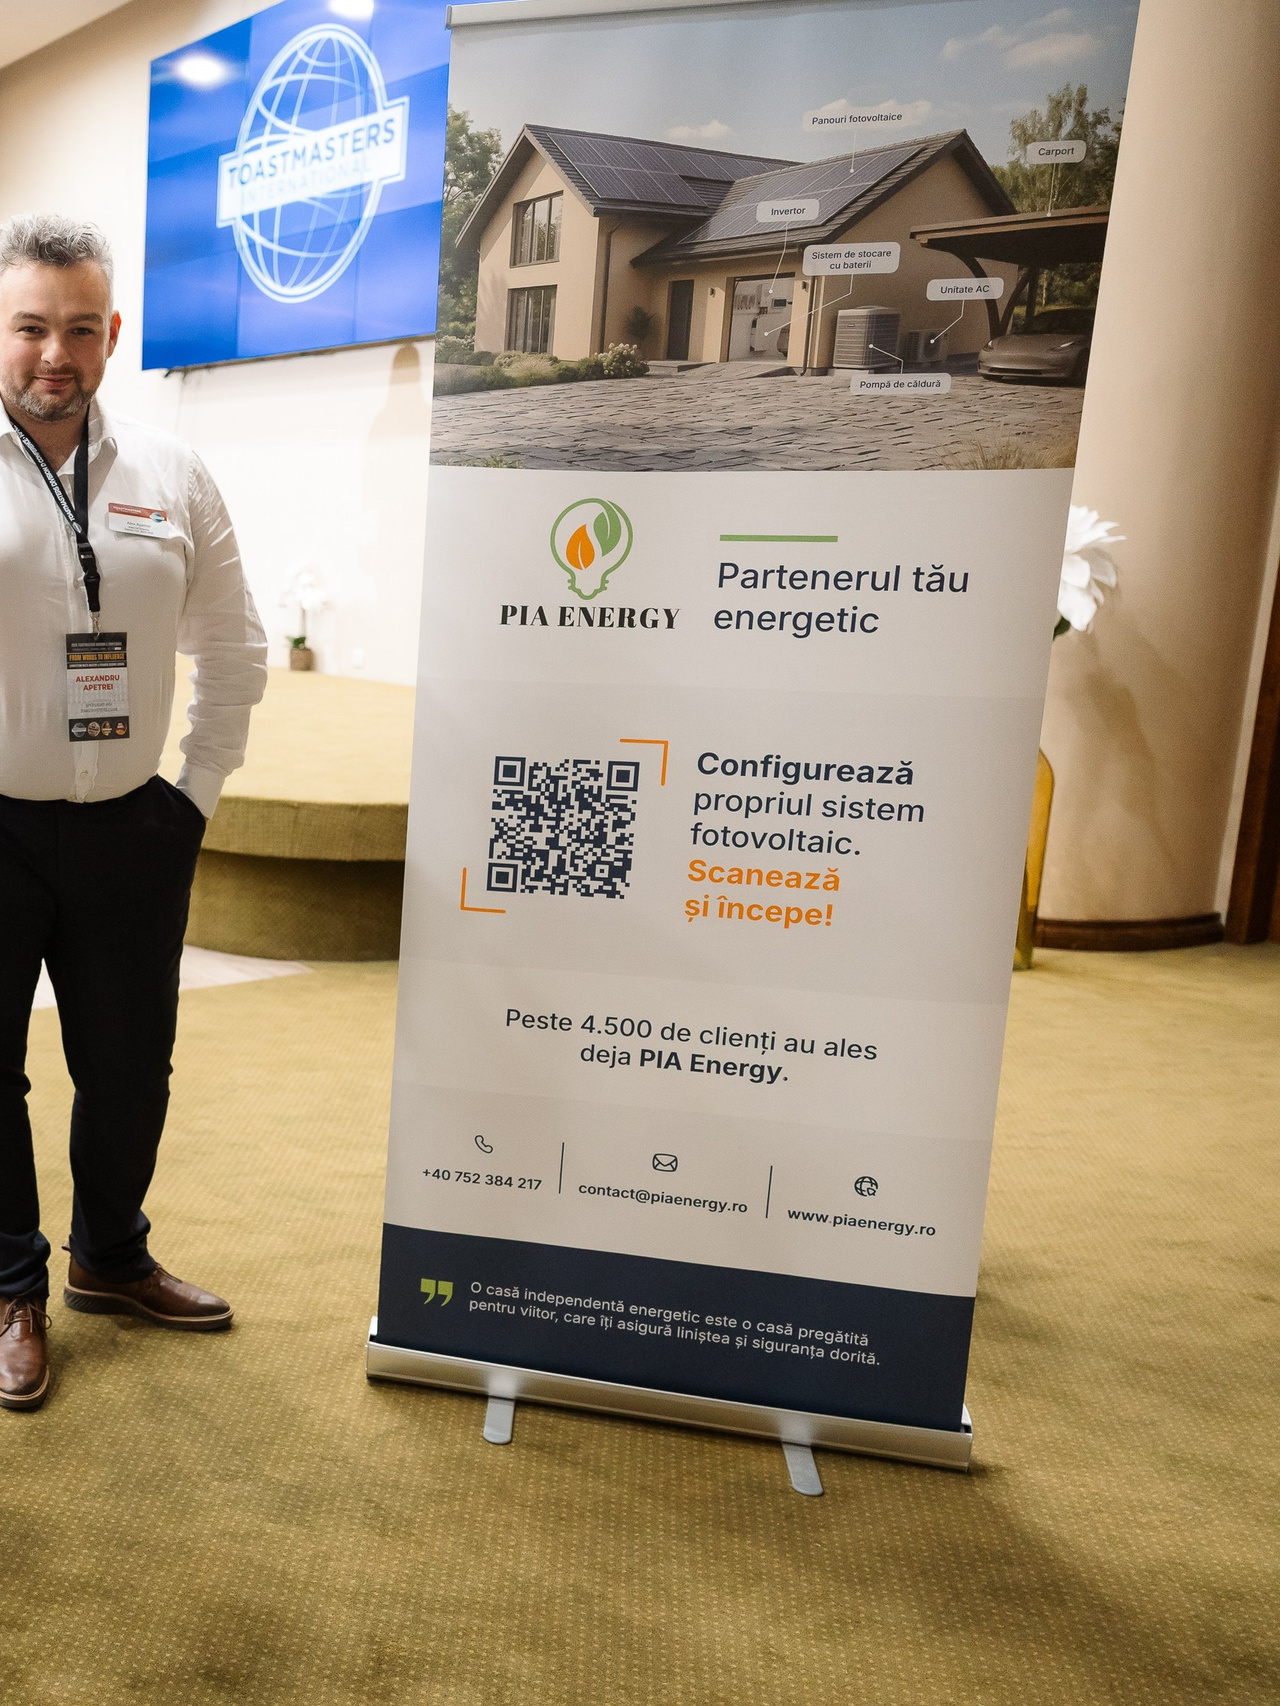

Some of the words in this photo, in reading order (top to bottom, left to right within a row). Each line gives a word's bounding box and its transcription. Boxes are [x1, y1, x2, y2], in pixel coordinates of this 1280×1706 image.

[811, 114, 847, 125] Panouri
[849, 113, 903, 123] fotovoltaice
[227, 119, 396, 190] TOASTMASTERS
[1038, 147, 1075, 158] Carport
[770, 207, 806, 216] Invertor
[811, 251, 841, 260] Sistem
[843, 250, 856, 259] de
[857, 250, 892, 258] stocare
[842, 261, 872, 270] baterii
[940, 286, 974, 295] Unitate
[975, 284, 990, 293] AC
[859, 380, 891, 390] Pompă
[893, 380, 905, 389] de
[908, 379, 941, 388] căldură
[718, 562, 901, 592] Partenerul
[912, 564, 969, 593] tău
[500, 604, 550, 627] PIA
[557, 606, 680, 630] ENERGY
[713, 605, 880, 639] energetic
[75, 674, 120, 683] ALEXANDRU
[82, 683, 114, 691] APETREI
[697, 752, 914, 786] Configurează
[693, 791, 813, 819] propriul
[821, 794, 925, 823] sistem
[690, 822, 861, 856] fotovoltaic.
[687, 859, 840, 892] Scanează
[684, 894, 710, 923] și
[716, 894, 834, 930] începe!
[506, 1008, 573, 1032] Peste
[580, 1014, 652, 1039] 4.500
[660, 1022, 691, 1043] de
[697, 1026, 777, 1056] clienți
[783, 1037, 815, 1055] au
[823, 1038, 878, 1061] ales
[580, 1043, 631, 1069] deja
[639, 1048, 682, 1071] PIA
[689, 1053, 788, 1085] Energy.
[422, 1168, 451, 1181] +40
[454, 1170, 481, 1185] 752
[484, 1174, 514, 1188] 384
[517, 1177, 543, 1191] 217
[578, 1184, 748, 1214] contact@piaenergy.ro
[787, 1209, 936, 1237] www.piaenergy.ro
[470, 1281, 482, 1294] O
[486, 1285, 520, 1299] casă
[522, 1287, 625, 1316] independentă
[628, 1304, 701, 1327] energetic
[704, 1315, 738, 1328] este
[742, 1320, 752, 1330] o
[756, 1322, 793, 1336] casă
[796, 1327, 869, 1351] pregătită
[469, 1300, 516, 1315] pentru
[520, 1305, 559, 1324] viitor,
[563, 1312, 596, 1326] care
[599, 1314, 613, 1331] îți
[617, 1317, 672, 1337] asigură
[676, 1326, 730, 1345] liniștea
[734, 1334, 748, 1349] și
[752, 1332, 827, 1360] siguranța
[829, 1348, 880, 1366] dorită.
